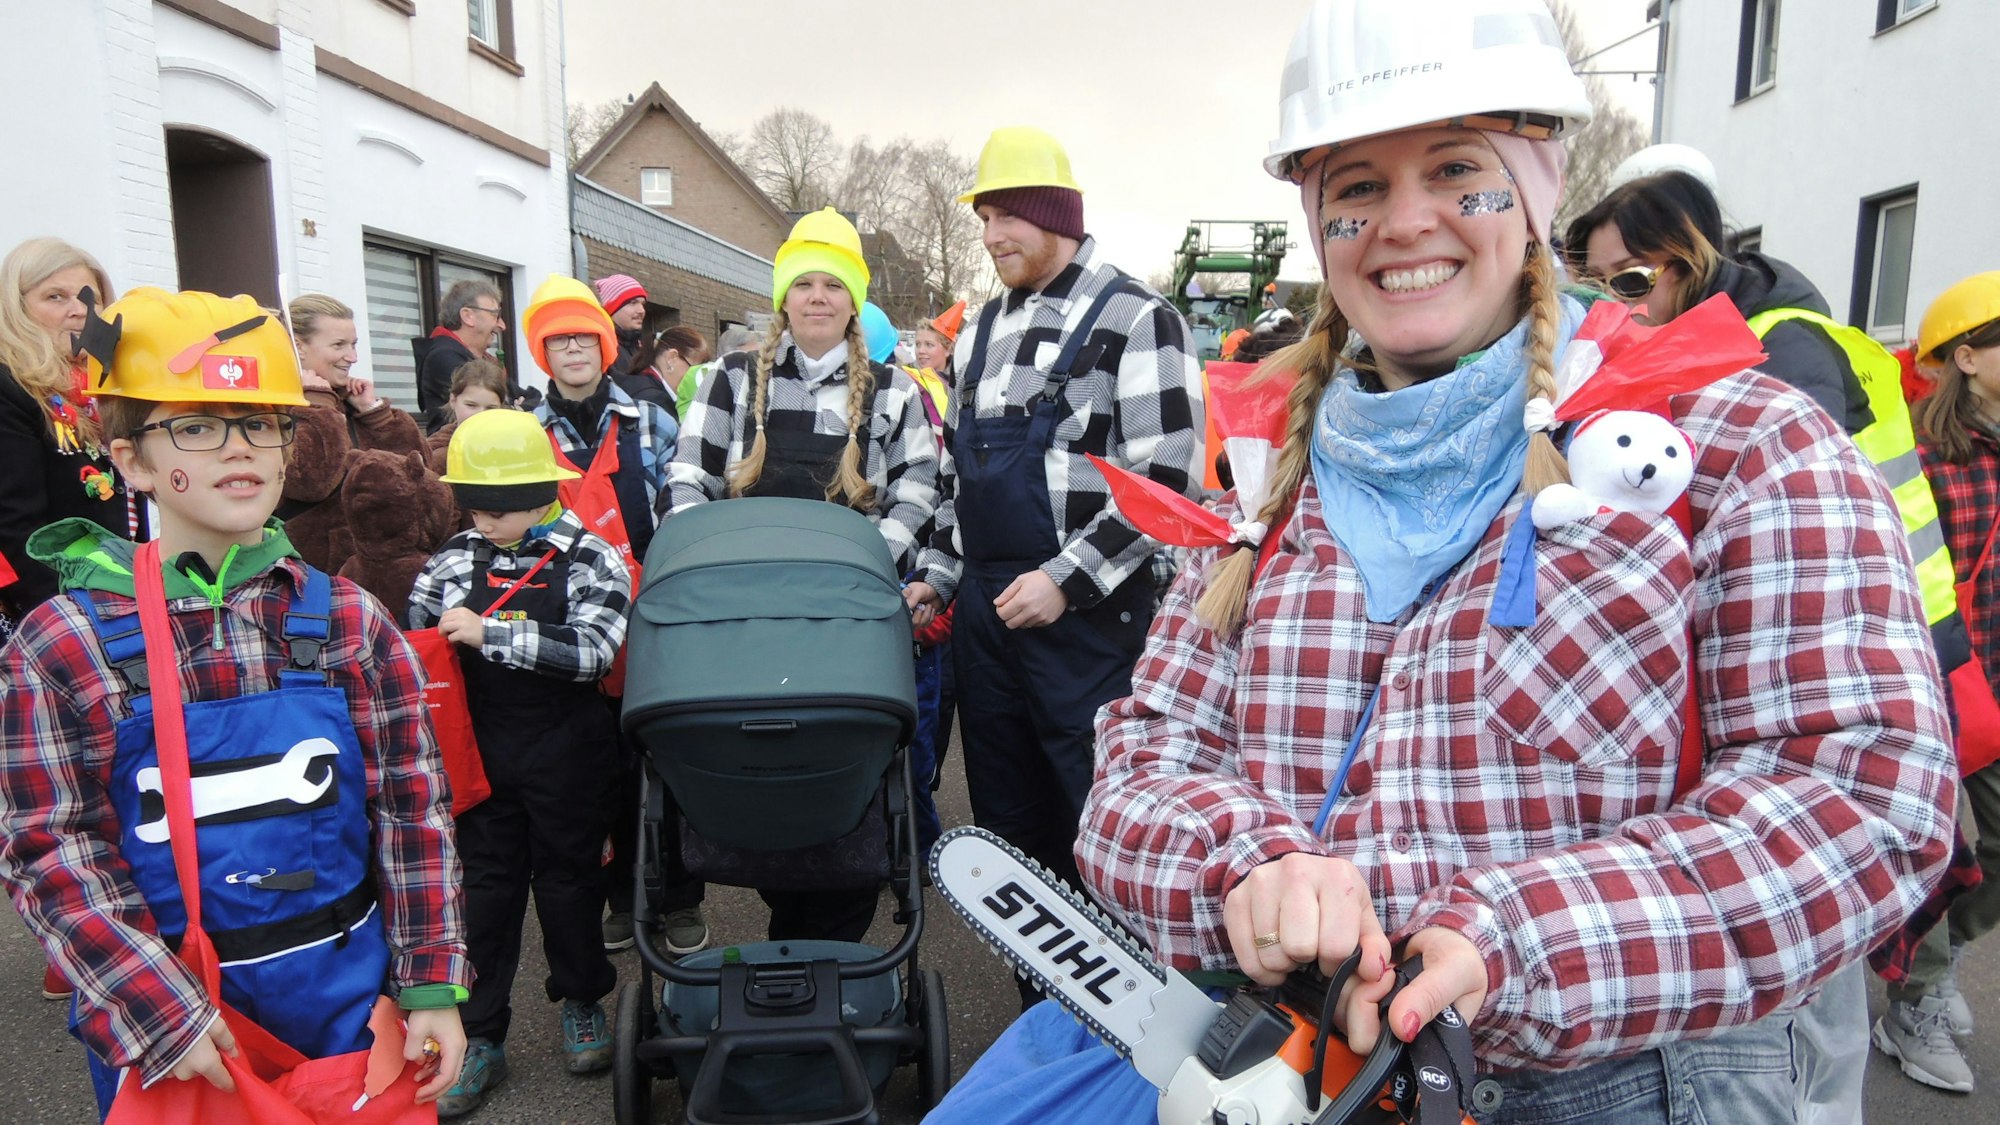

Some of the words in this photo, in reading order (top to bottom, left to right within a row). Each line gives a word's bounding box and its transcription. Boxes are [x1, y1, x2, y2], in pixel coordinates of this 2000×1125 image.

[1328, 80, 1354, 95] UTE
[1361, 62, 1443, 86] PFEIFFER
[491, 610, 528, 621] SUPER
[982, 881, 1121, 1005] STIHL
[1394, 1074, 1407, 1099] RCF
[1422, 1071, 1447, 1086] RCF
